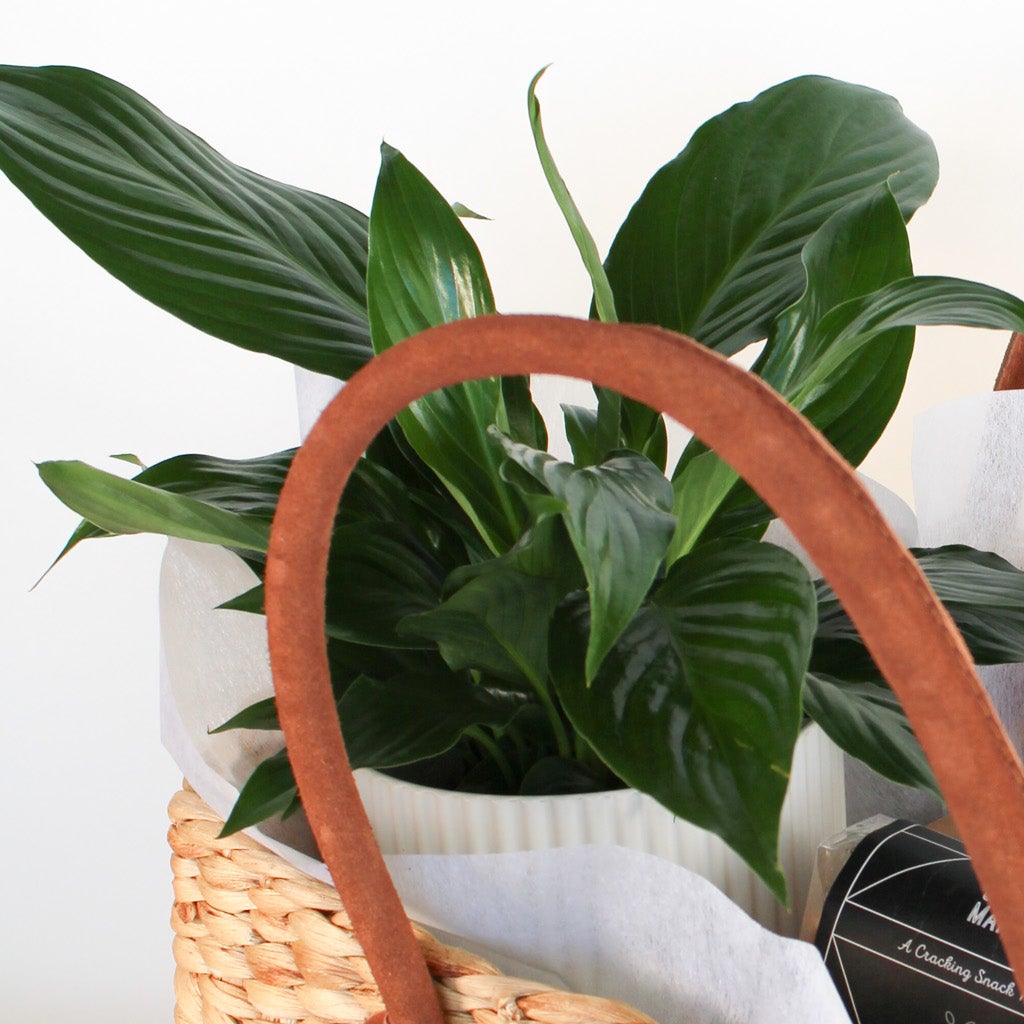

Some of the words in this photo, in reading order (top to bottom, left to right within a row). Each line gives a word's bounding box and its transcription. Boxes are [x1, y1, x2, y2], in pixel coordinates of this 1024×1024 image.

[965, 900, 1001, 934] MA
[897, 939, 913, 954] A
[915, 944, 972, 982] Cracking
[974, 968, 1016, 997] Snack
